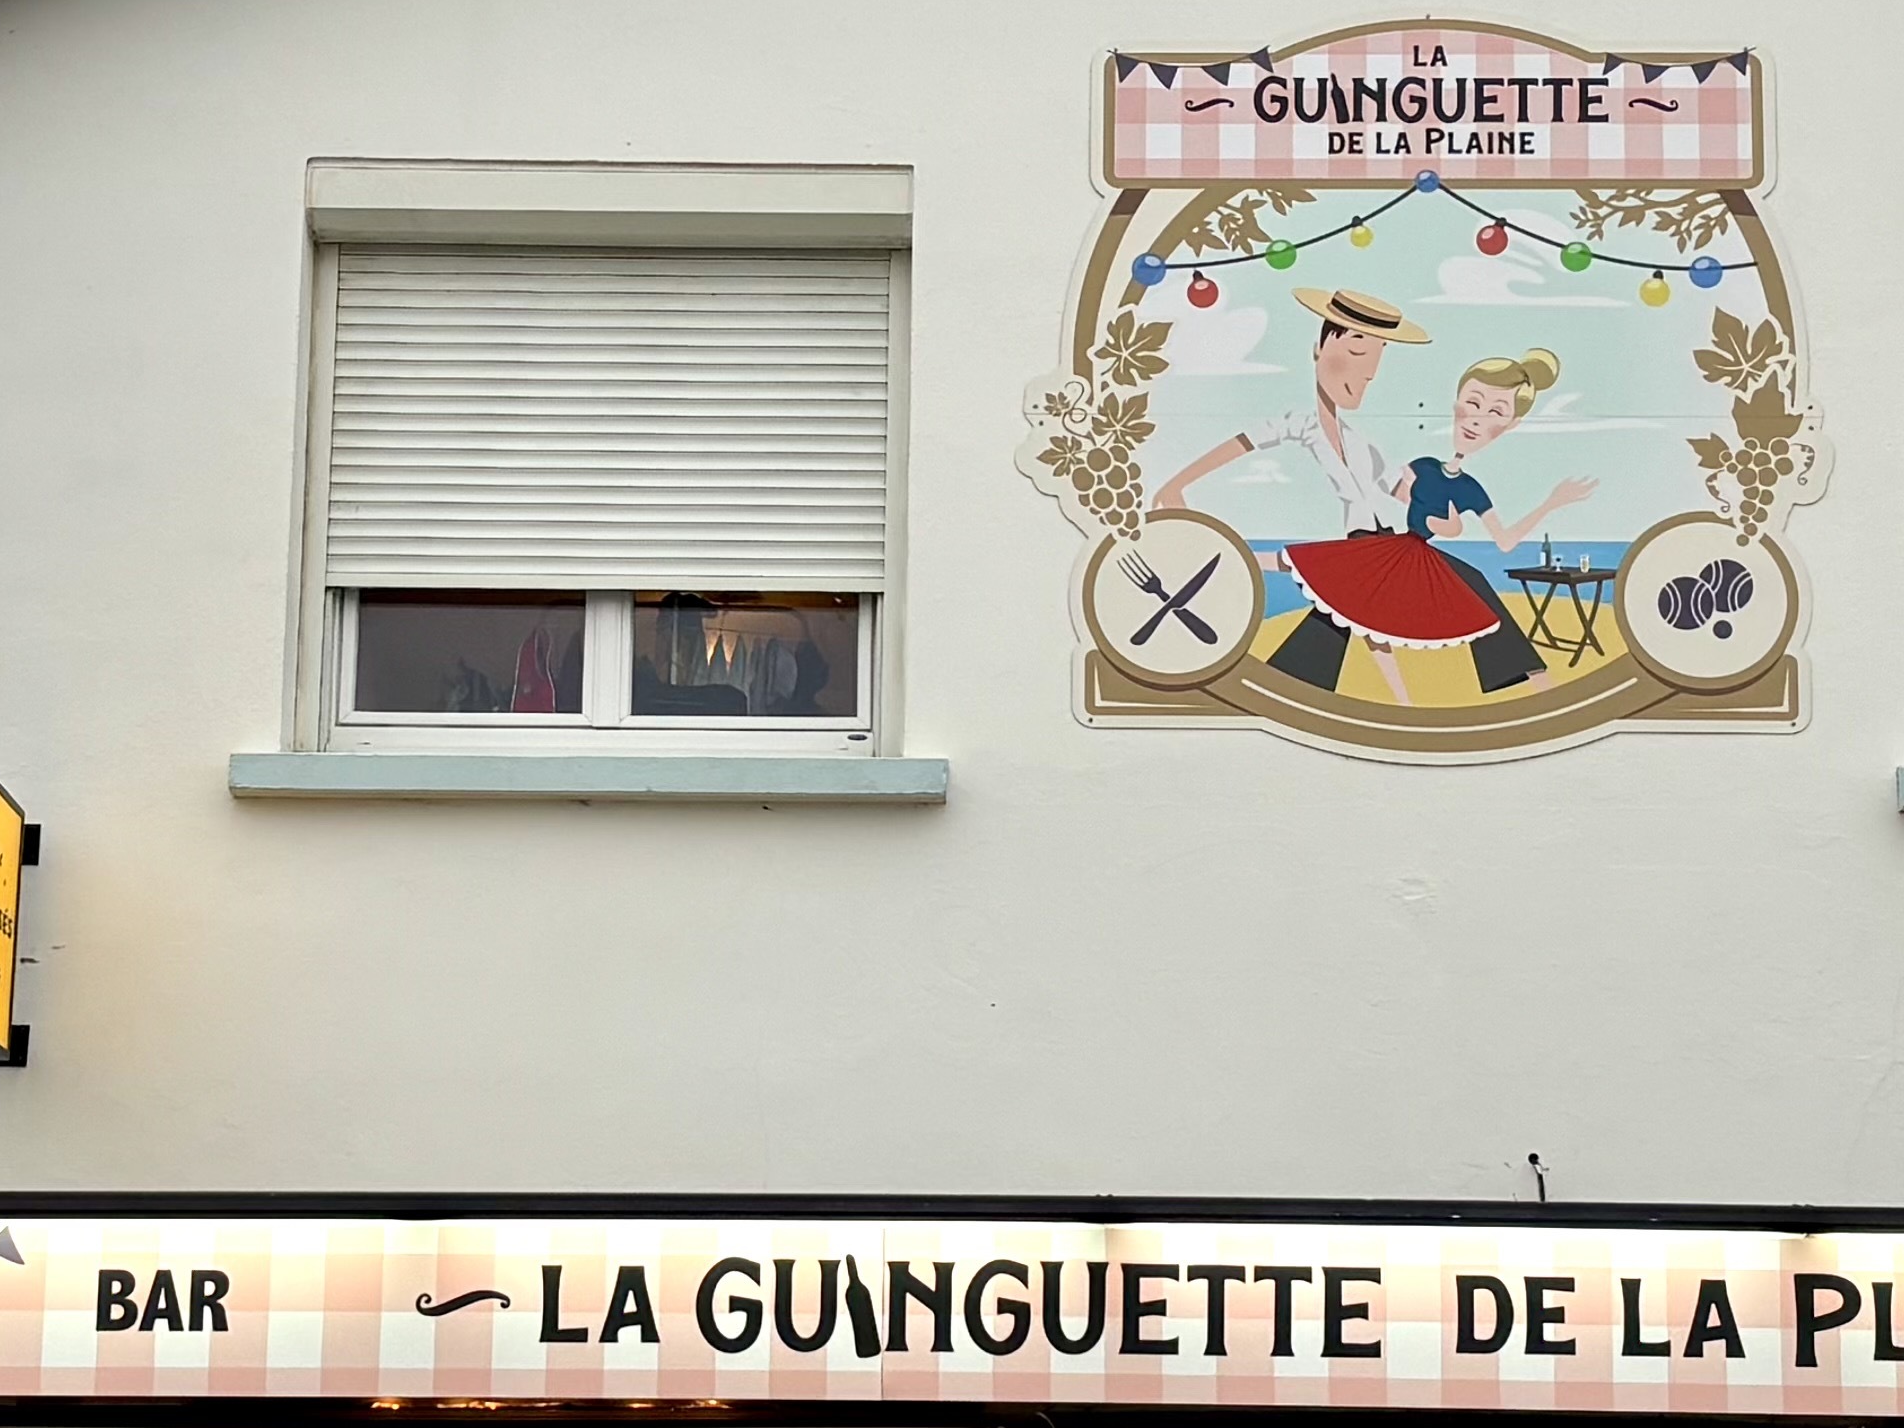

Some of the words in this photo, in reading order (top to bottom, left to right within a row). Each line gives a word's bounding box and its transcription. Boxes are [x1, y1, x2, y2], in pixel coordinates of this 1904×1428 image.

[1413, 45, 1447, 67] LA
[1253, 73, 1610, 124] GUINGUETTE
[1328, 131, 1364, 154] DE
[1375, 132, 1412, 154] LA
[1425, 127, 1535, 154] PLAINE
[96, 1268, 231, 1333] BAR
[538, 1264, 661, 1344] LA
[695, 1254, 1384, 1359] GUINGUETTE
[1454, 1274, 1577, 1355] DE
[1620, 1277, 1746, 1360] LA
